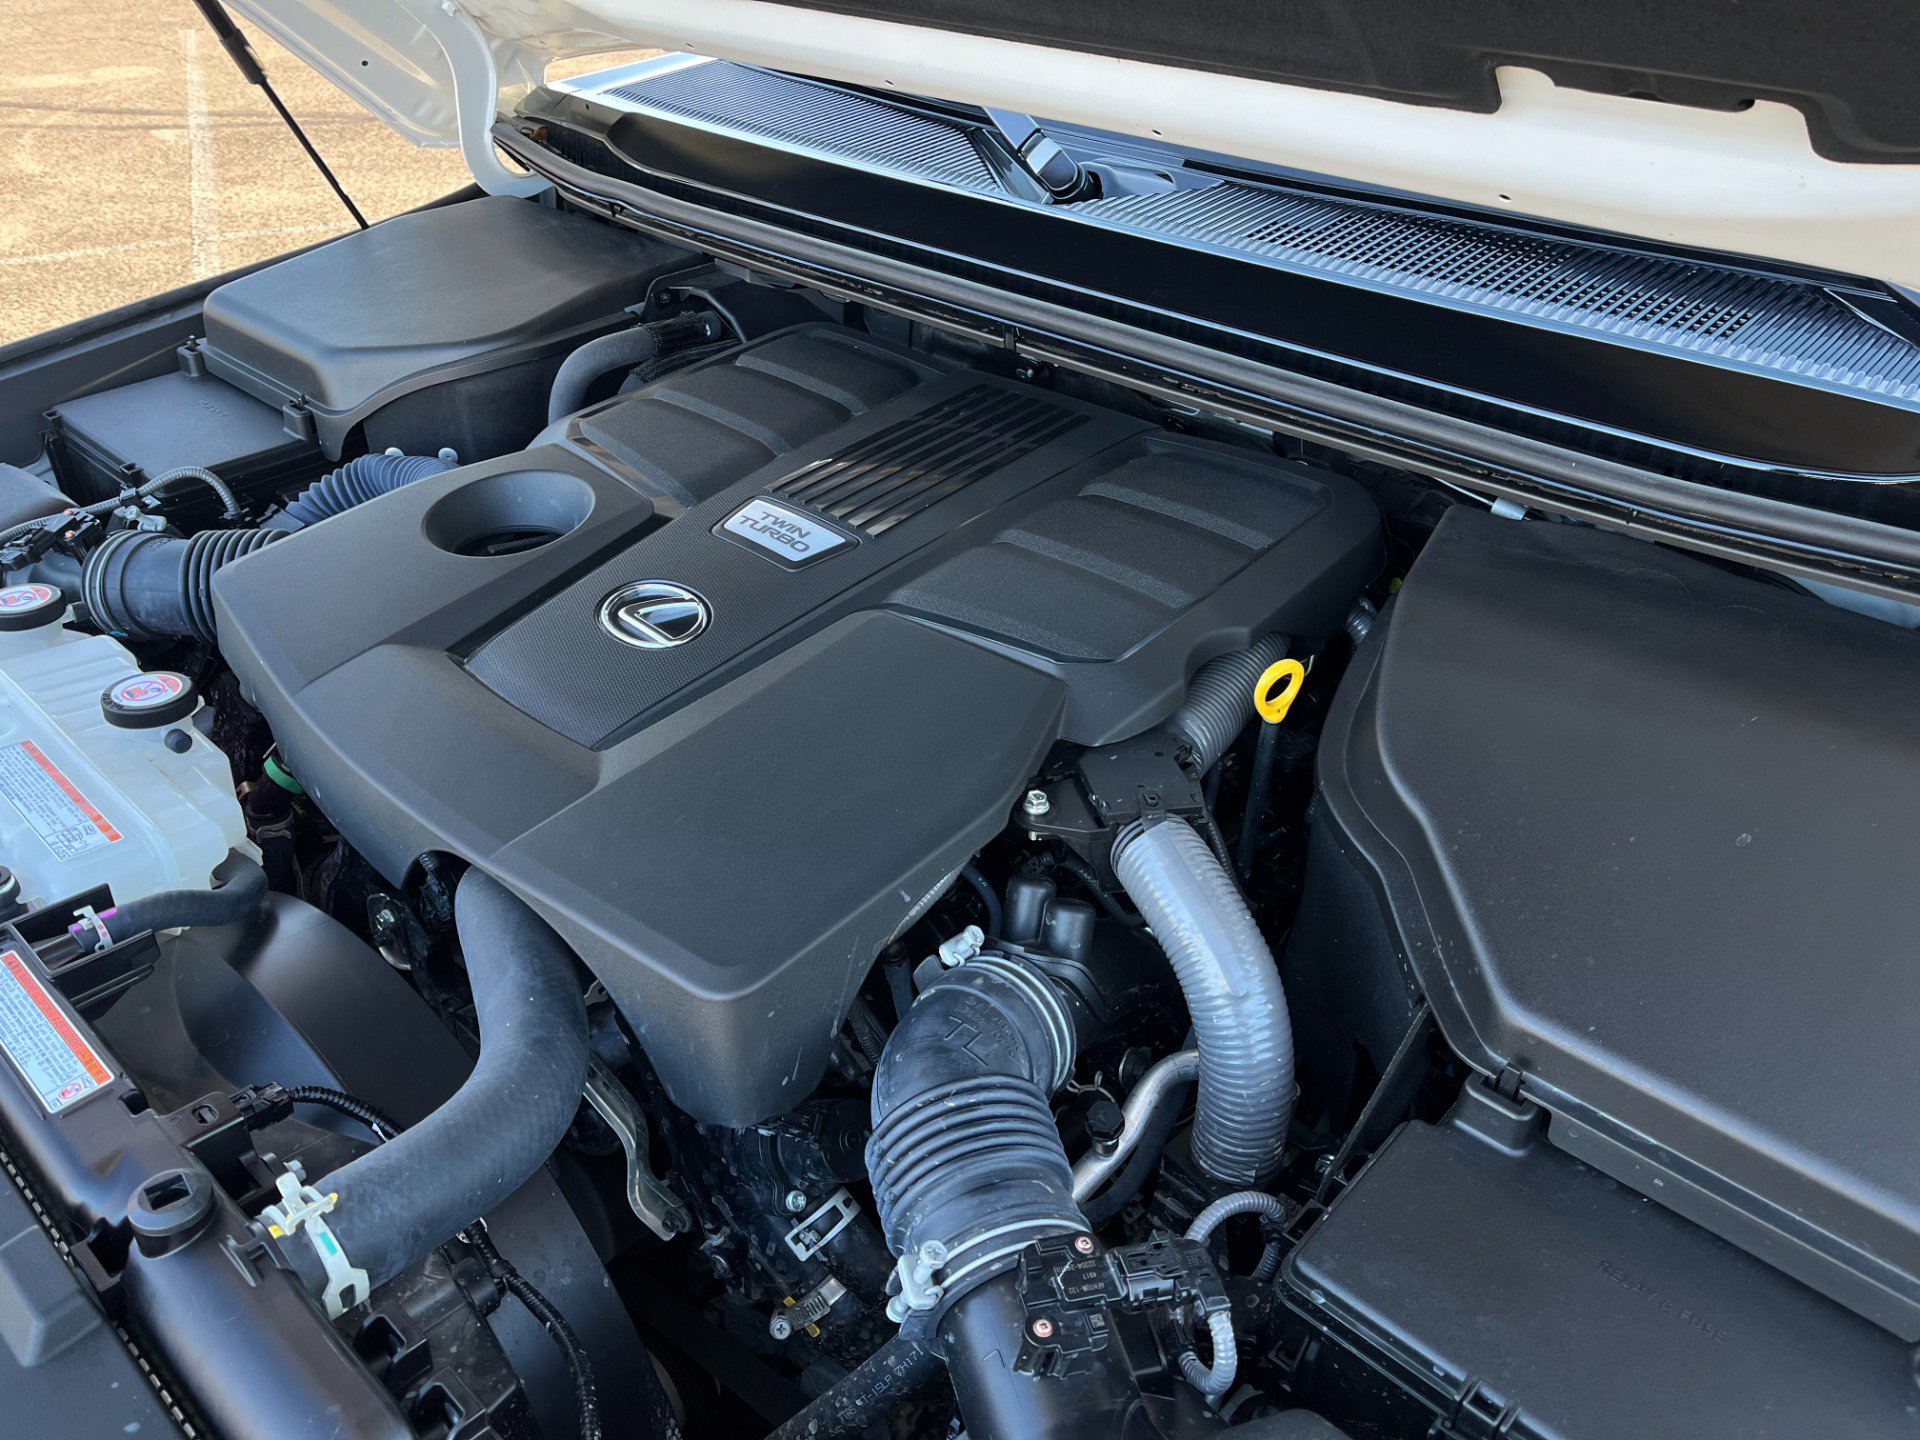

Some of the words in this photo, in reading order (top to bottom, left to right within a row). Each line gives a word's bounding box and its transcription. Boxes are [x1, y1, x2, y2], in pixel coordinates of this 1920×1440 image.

[739, 515, 811, 553] TURBO
[760, 511, 811, 540] TWIN
[1598, 1260, 1660, 1301] RELAY
[1660, 1299, 1674, 1313] &
[1676, 1308, 1728, 1345] FUSE
